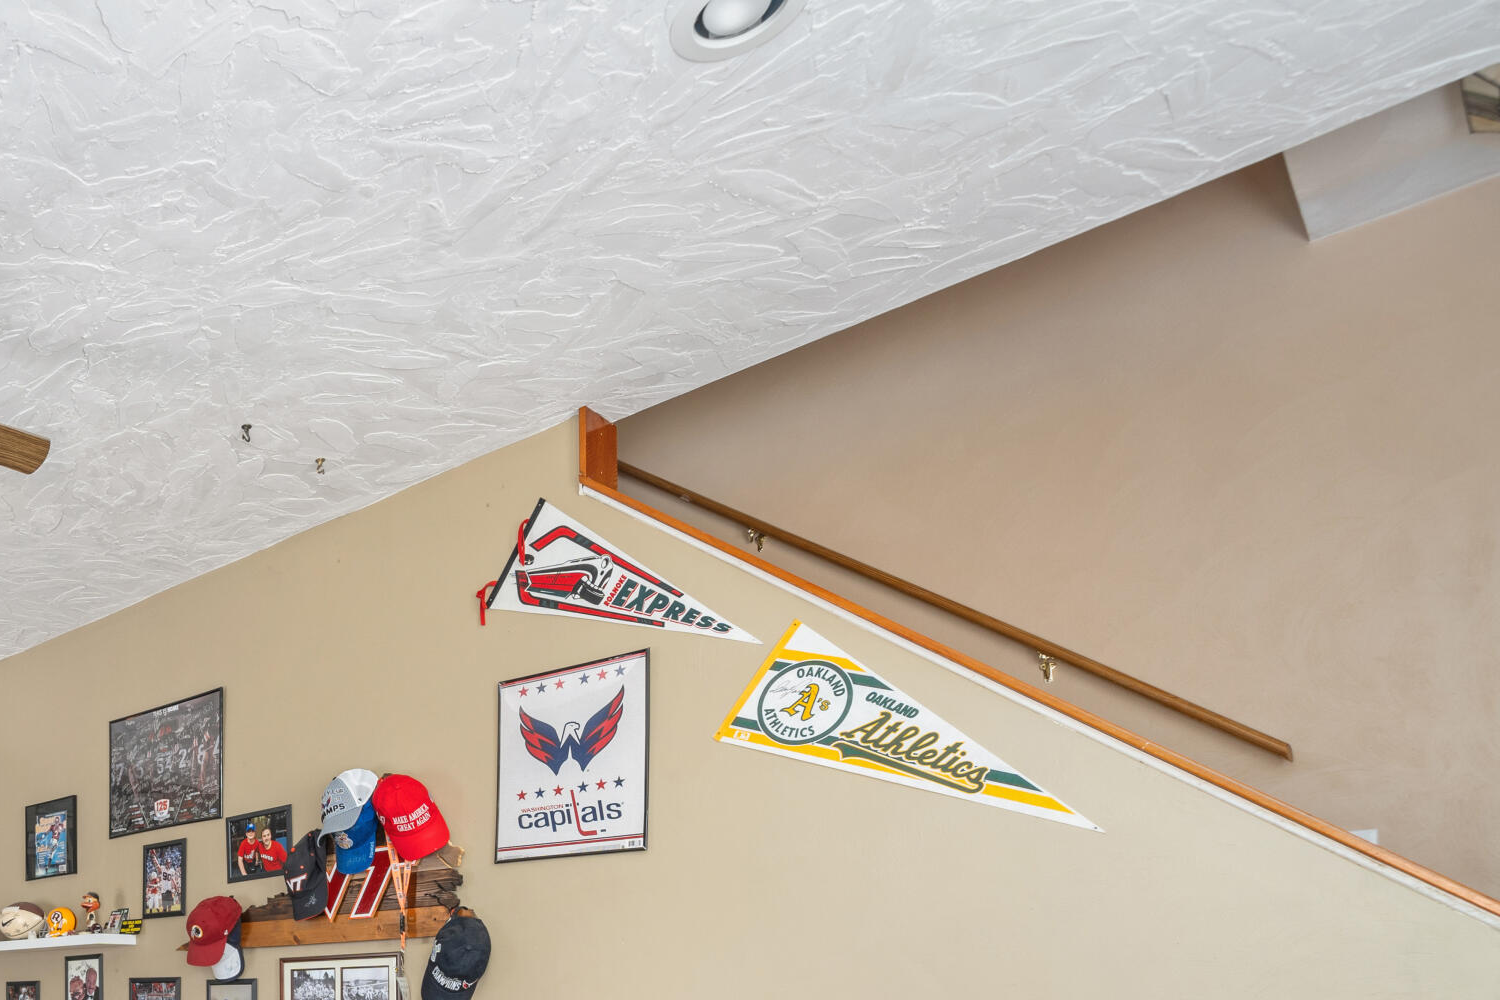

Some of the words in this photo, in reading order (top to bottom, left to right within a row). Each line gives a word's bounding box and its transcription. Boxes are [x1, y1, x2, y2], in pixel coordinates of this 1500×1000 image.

[604, 574, 627, 606] ROANOKE
[610, 578, 733, 634] EXPRESS
[796, 667, 845, 697] OAKLAND
[865, 691, 919, 719] OAKLAND
[764, 708, 815, 738] ATHLETICS
[839, 711, 989, 786] Athletics
[156, 800, 168, 812] 125
[392, 815, 408, 825] MAKE
[408, 803, 429, 822] AMERICA
[518, 790, 622, 836] capitals
[521, 804, 564, 814] WASHINGTON
[397, 822, 415, 832] GREAT
[416, 811, 431, 827] AGAIN
[286, 873, 307, 892] VT
[432, 966, 462, 991] CHAMPIONS
